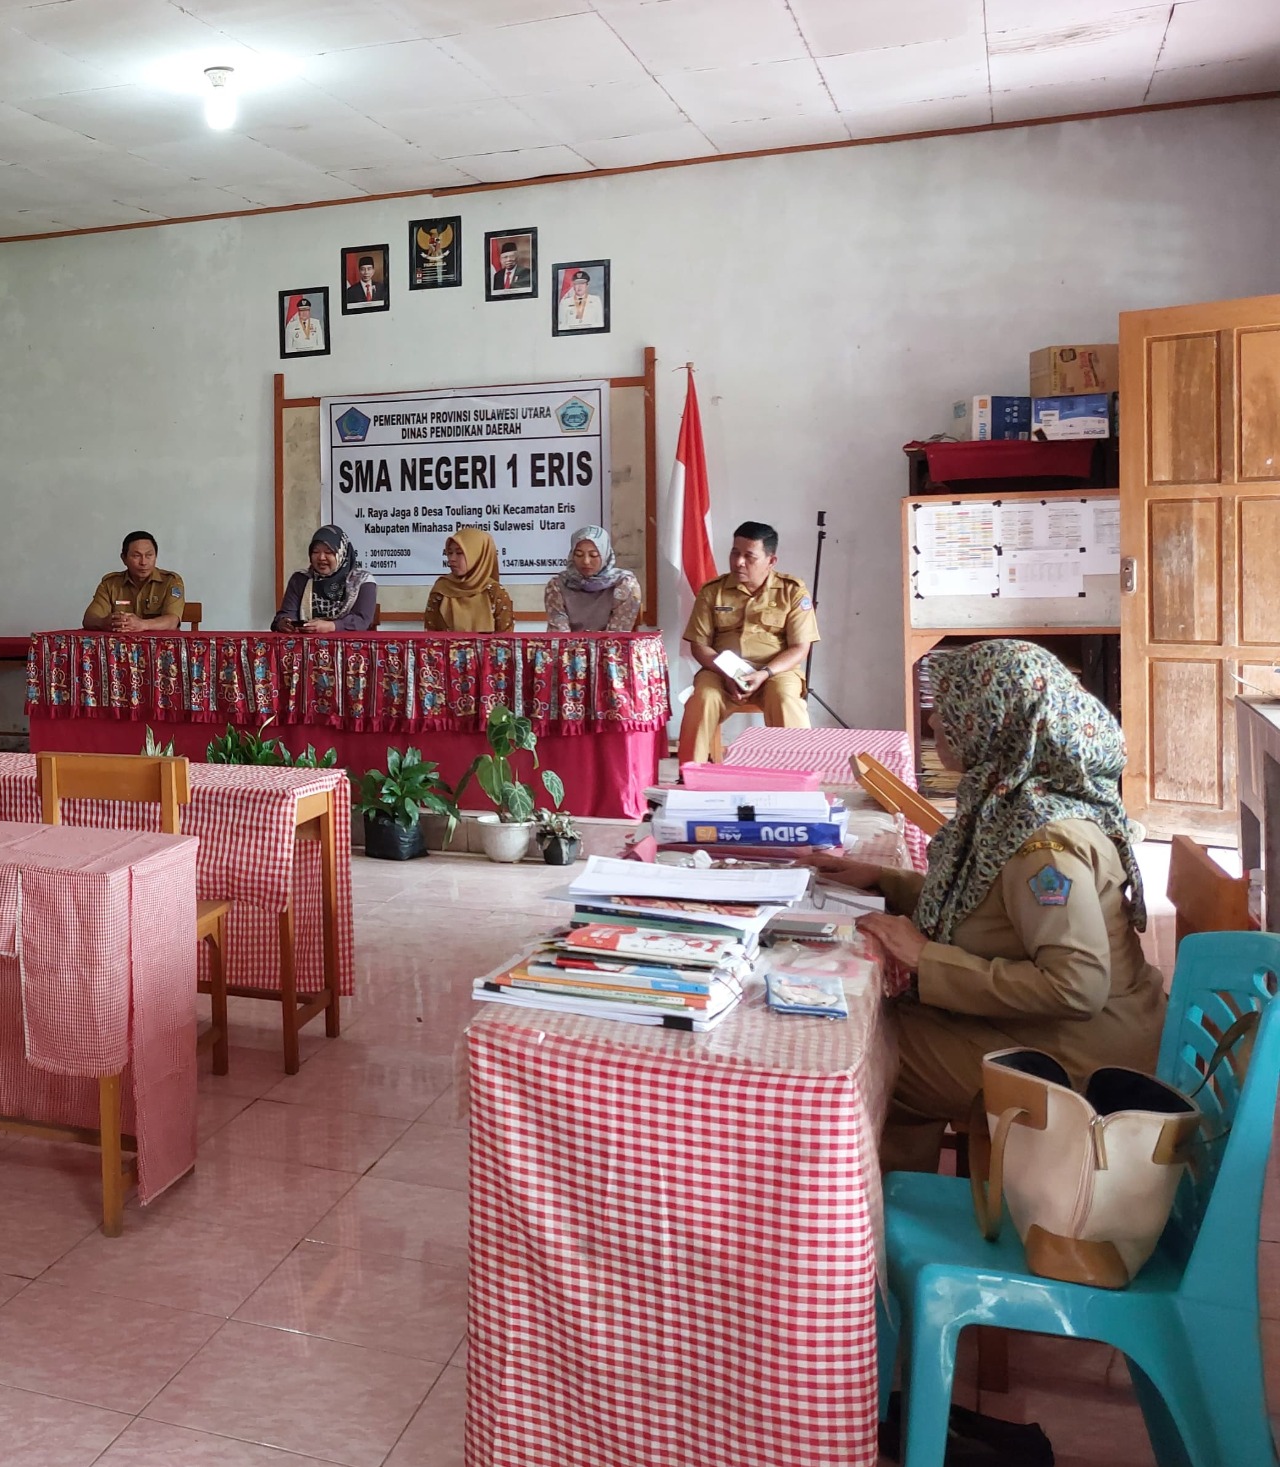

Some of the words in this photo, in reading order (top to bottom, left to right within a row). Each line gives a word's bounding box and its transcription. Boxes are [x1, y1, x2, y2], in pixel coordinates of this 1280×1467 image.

[373, 412, 428, 427] PEMERINTAH
[430, 410, 470, 424] PROVINSI
[473, 408, 519, 422] SULAWESI
[521, 406, 552, 419] UTARA
[401, 426, 428, 440] DINAS
[430, 424, 483, 438] PENDIDIKAN
[485, 423, 522, 436] DAERAH
[339, 459, 392, 493] SMA
[400, 455, 496, 492] NEGERI
[506, 453, 518, 488] 1
[530, 450, 593, 488] ERIS
[354, 507, 365, 519] Jl.
[367, 507, 389, 520] Raya
[390, 507, 411, 520] Jaga
[413, 506, 419, 517] 8
[421, 506, 443, 517] Desa
[445, 505, 483, 518] Touliang
[485, 504, 500, 515] Oki
[503, 504, 555, 515] Kecamatan
[557, 503, 576, 513] Eris
[364, 523, 410, 536] Kabupaten
[412, 522, 453, 533] Minahasa
[493, 520, 534, 532] Sulawesi
[539, 520, 566, 530] Utara
[502, 558, 568, 568] 1347/BAN-SM/SK/20
[760, 826, 809, 842] SiDU
